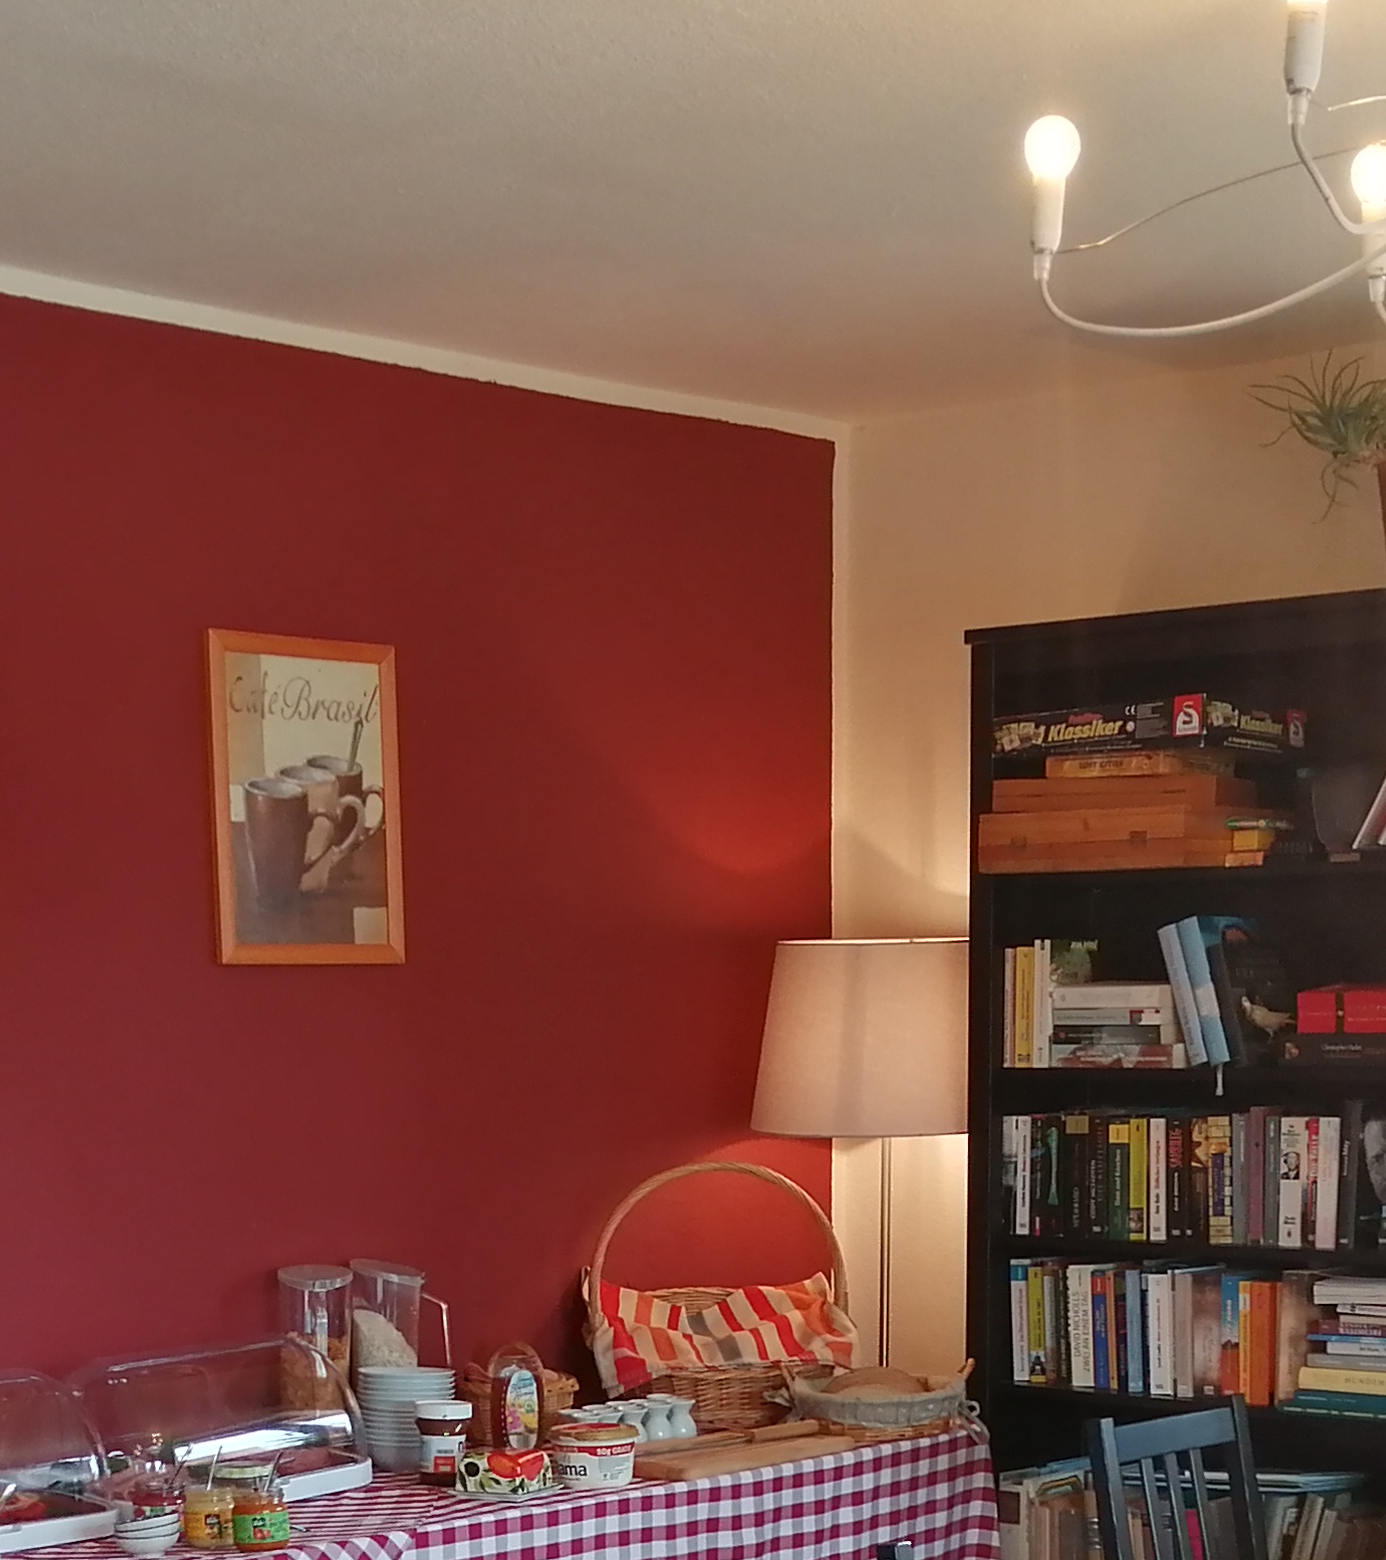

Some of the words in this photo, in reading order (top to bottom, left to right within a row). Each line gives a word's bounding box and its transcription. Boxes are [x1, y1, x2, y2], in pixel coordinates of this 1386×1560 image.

[280, 677, 379, 723] Brasil
[1047, 719, 1124, 741] Klassiker
[558, 1463, 587, 1477] ama
